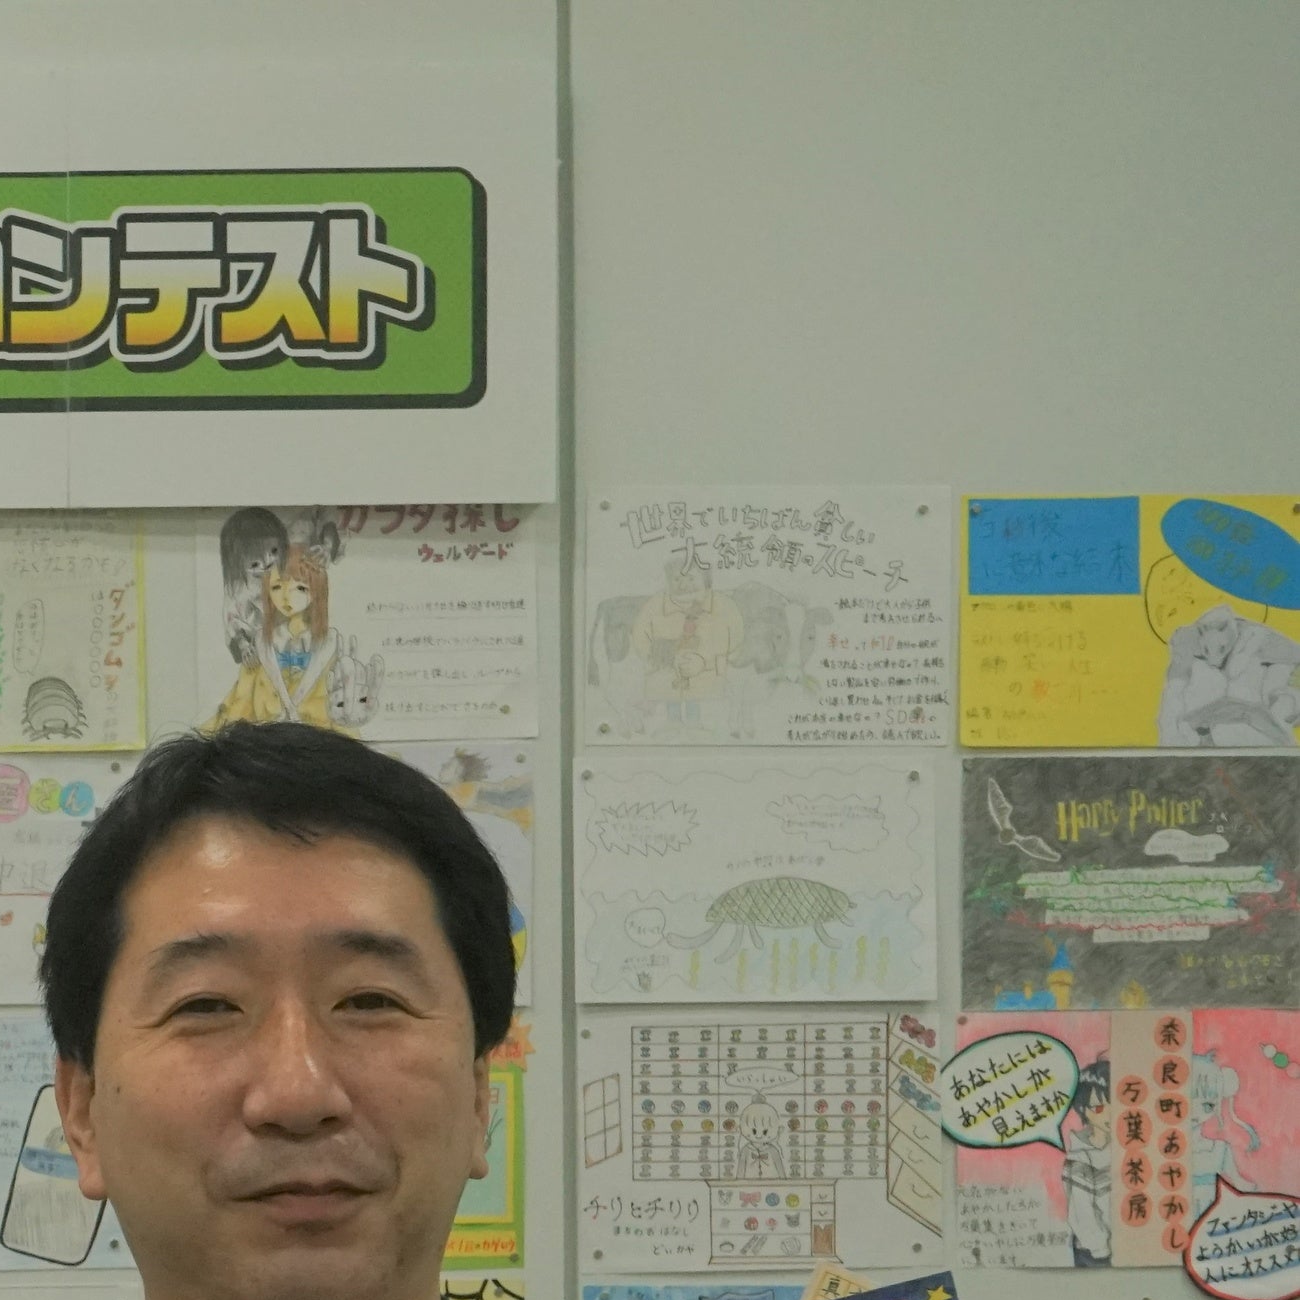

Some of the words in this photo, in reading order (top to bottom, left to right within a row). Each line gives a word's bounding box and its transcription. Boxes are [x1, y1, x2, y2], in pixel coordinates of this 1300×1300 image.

[1056, 799, 1121, 844] Harry
[1127, 789, 1205, 836] Potter
[949, 1038, 1053, 1103] あなたには
[956, 1067, 1054, 1130] あやかしが
[989, 1091, 1071, 1142] 見えますか
[1158, 1016, 1189, 1254] 奈良町あやかし
[1120, 1082, 1150, 1222] 万葉茶房
[583, 1194, 700, 1224] チリとチリリ
